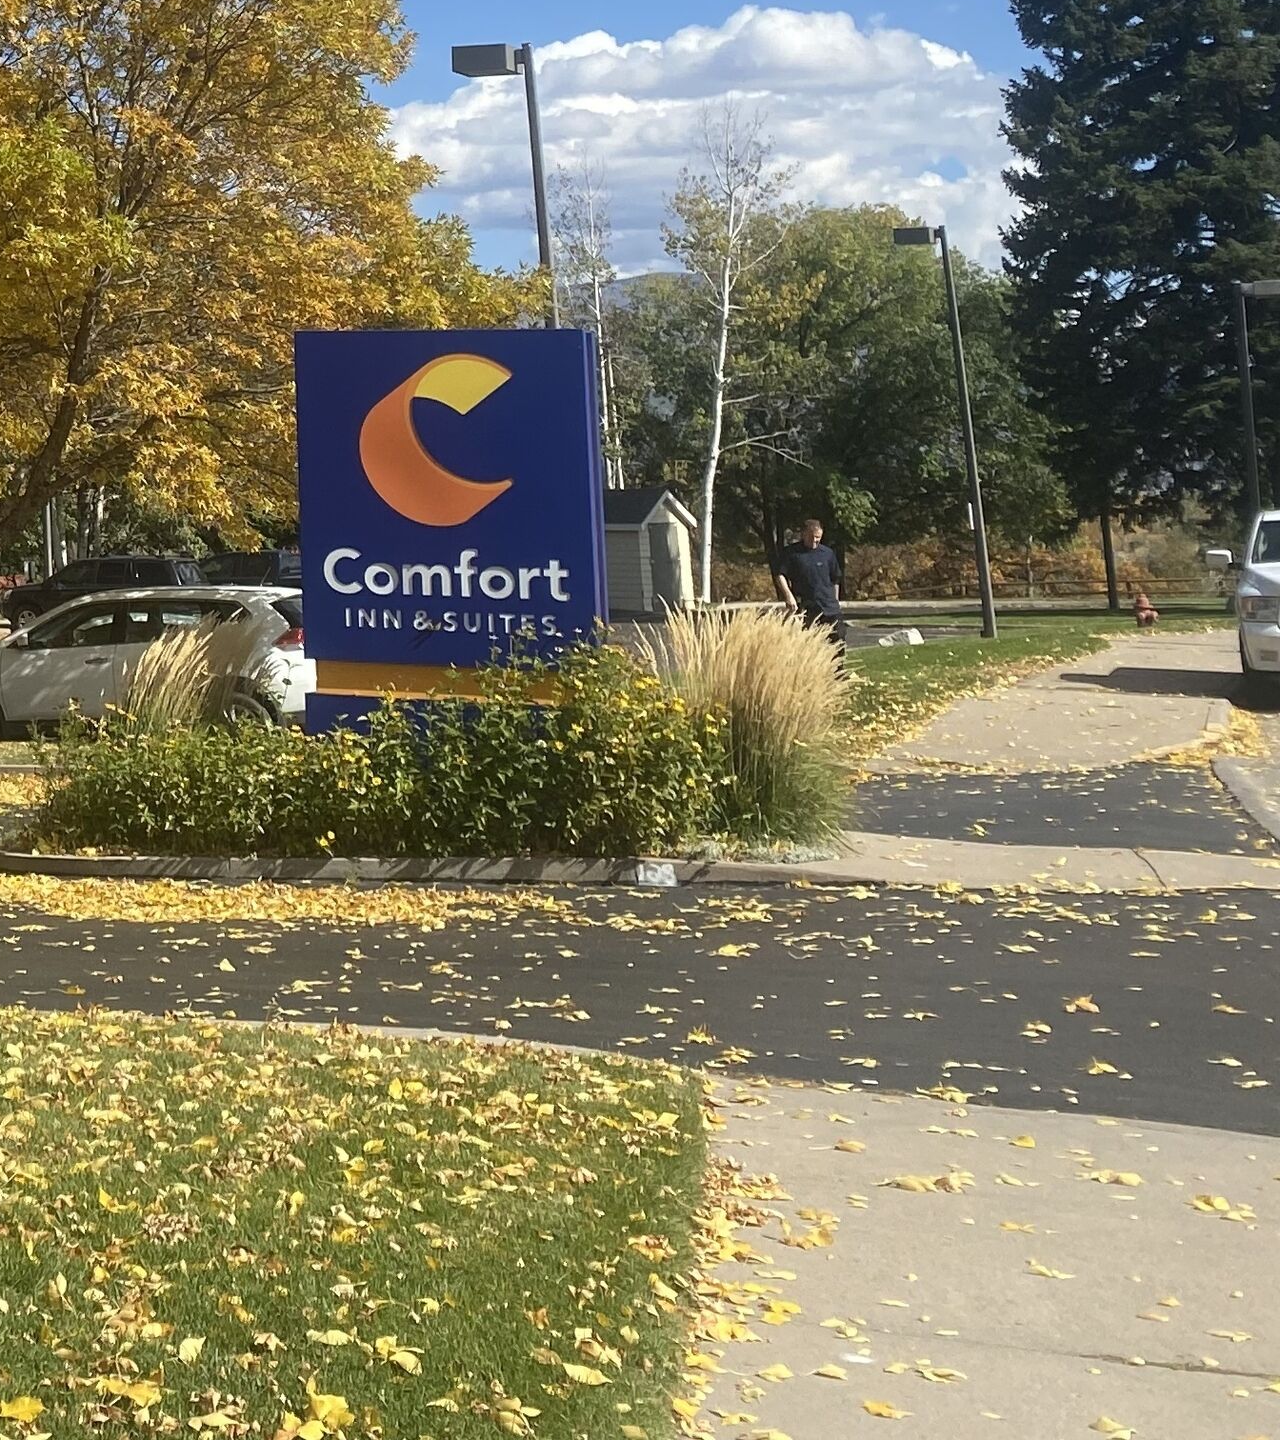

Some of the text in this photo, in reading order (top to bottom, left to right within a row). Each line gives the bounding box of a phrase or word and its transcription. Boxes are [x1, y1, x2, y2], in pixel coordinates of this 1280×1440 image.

[323, 548, 571, 602] Comfort
[345, 607, 558, 636] INN & SUITES
